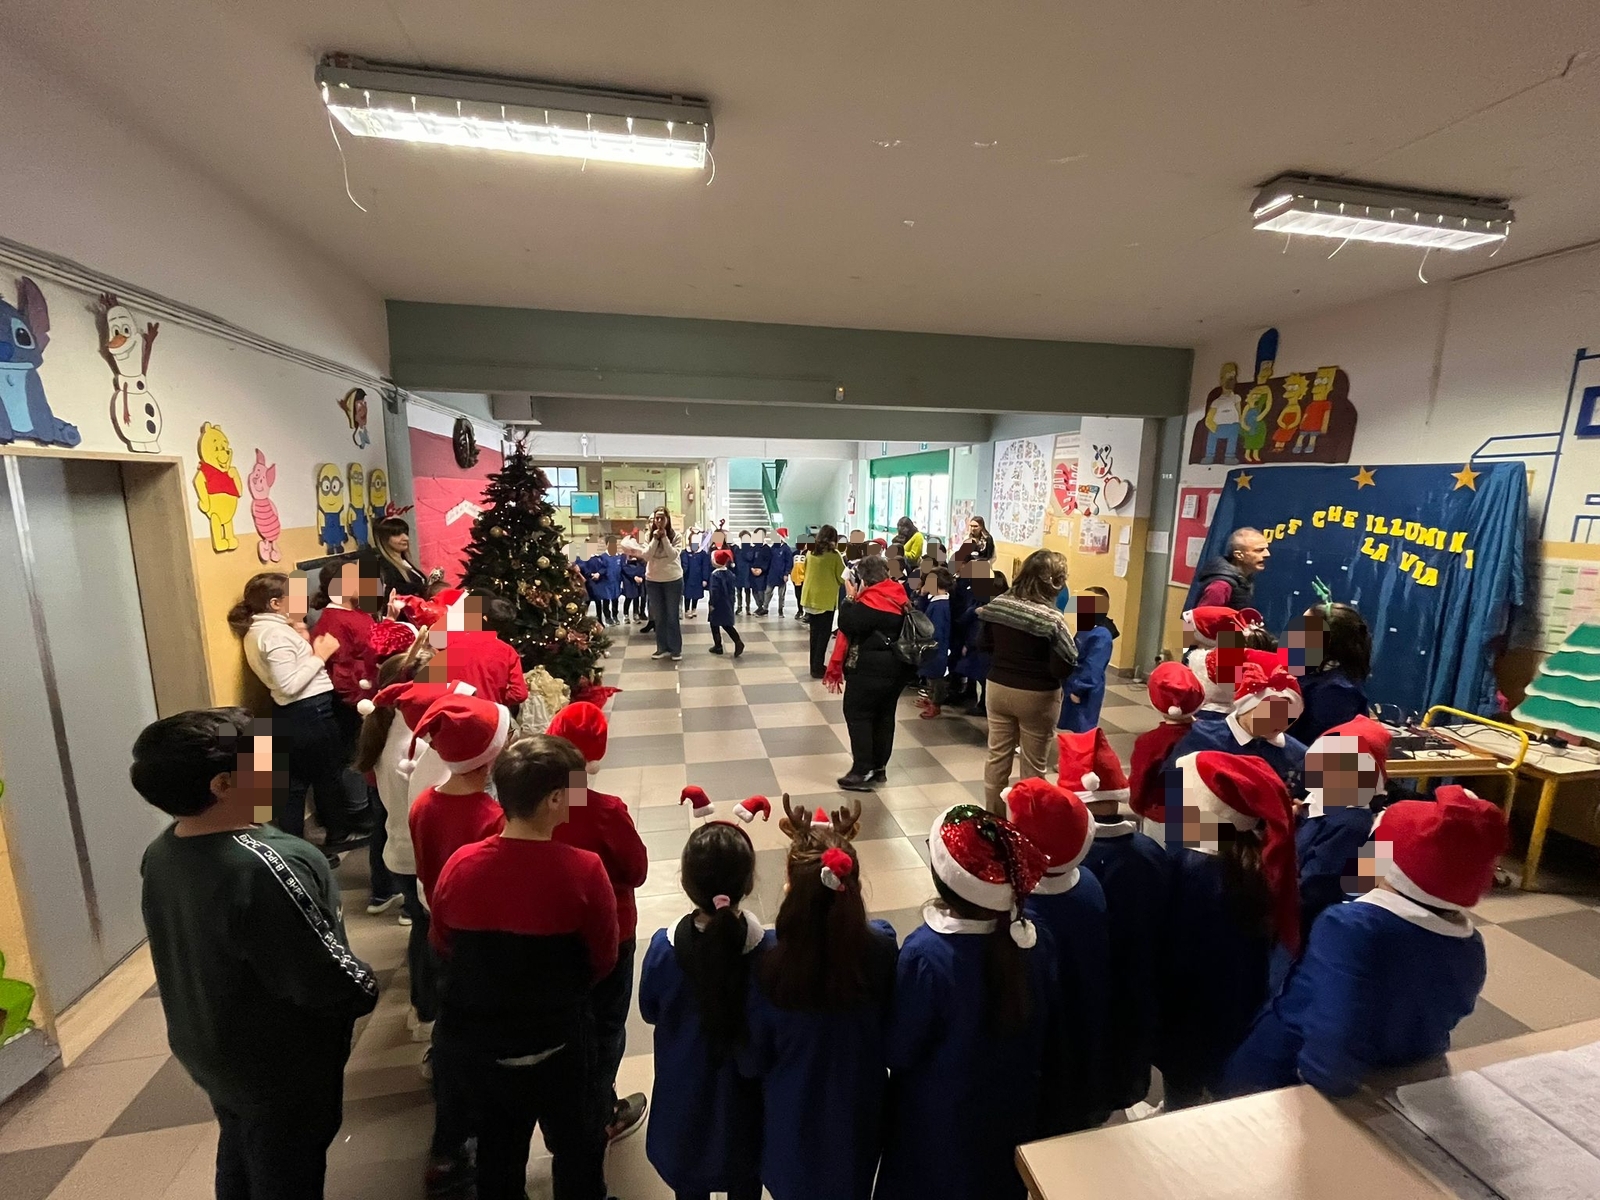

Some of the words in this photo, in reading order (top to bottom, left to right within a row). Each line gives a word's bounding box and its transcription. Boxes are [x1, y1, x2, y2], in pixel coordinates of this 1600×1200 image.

[1312, 506, 1359, 529] CHE
[1361, 538, 1390, 562] LA
[1399, 552, 1439, 587] VIA
[264, 850, 285, 872] BHPC
